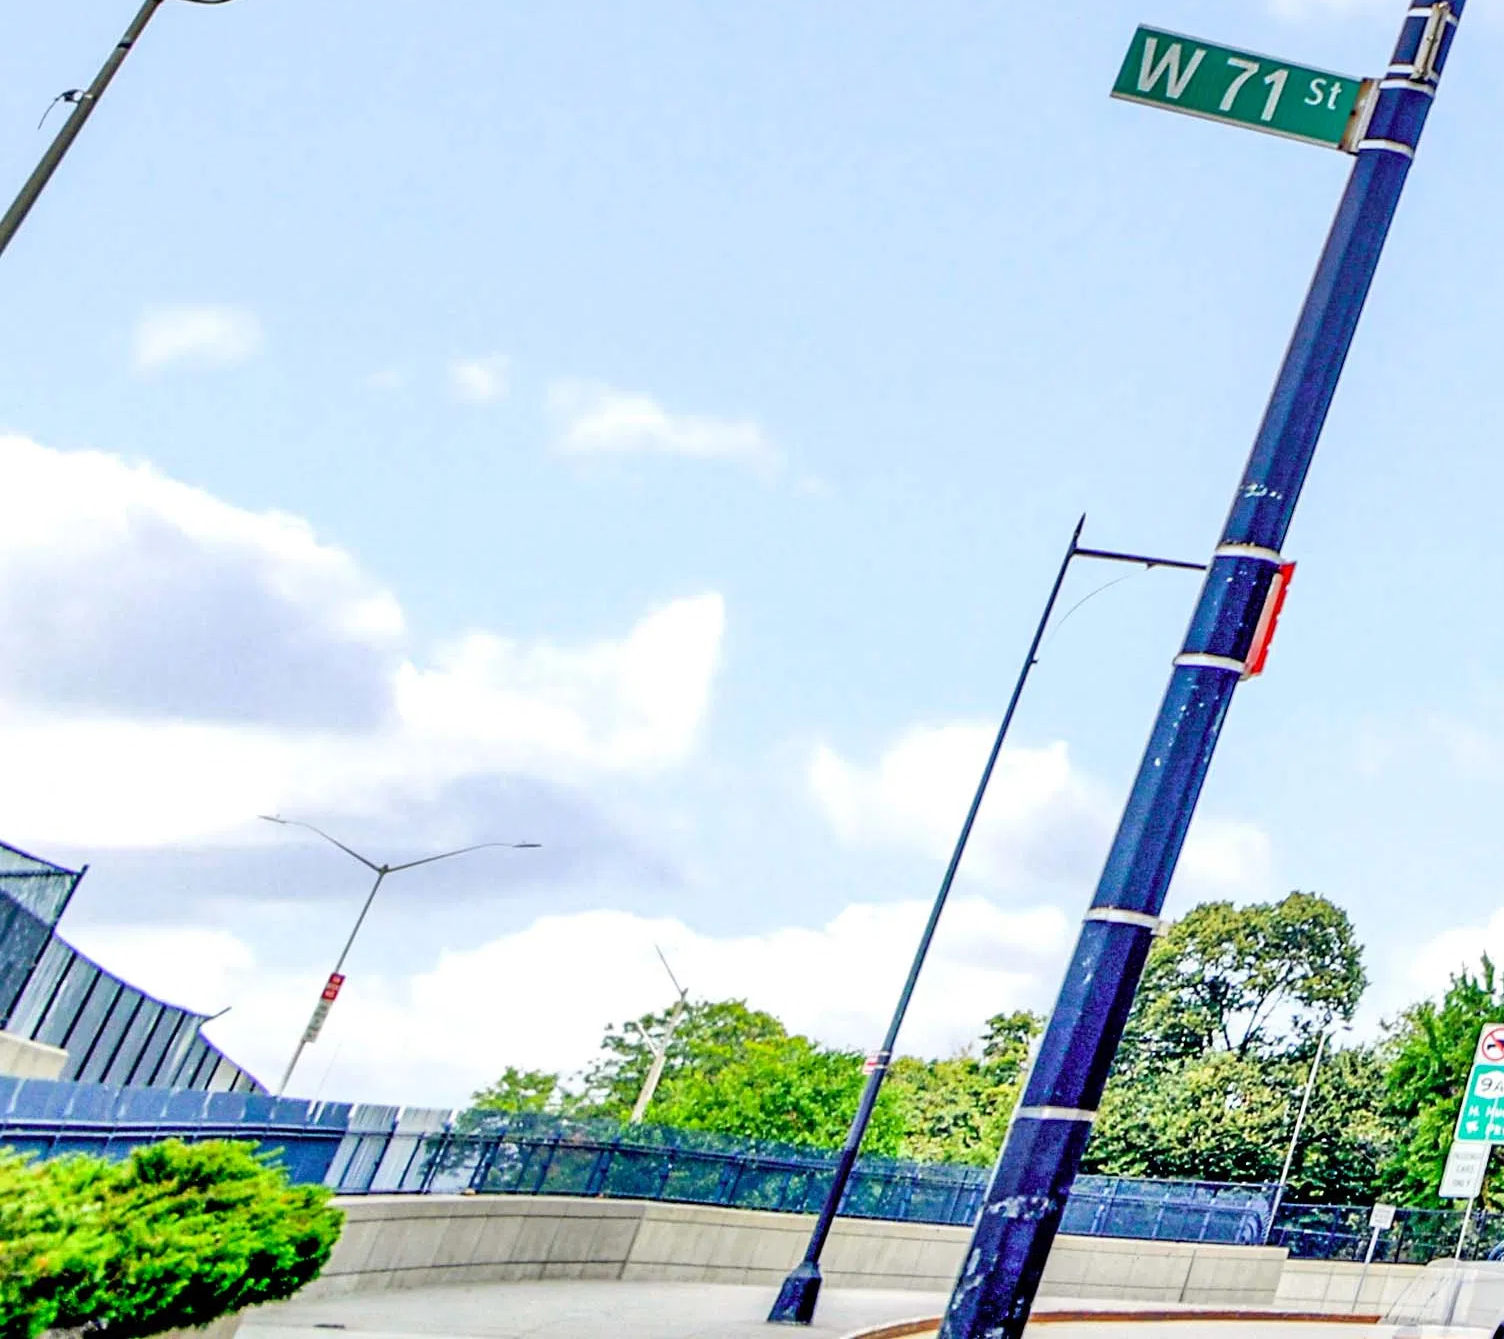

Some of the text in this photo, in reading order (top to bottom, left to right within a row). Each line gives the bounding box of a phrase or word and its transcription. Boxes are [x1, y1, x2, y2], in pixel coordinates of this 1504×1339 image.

[1136, 36, 1342, 122] W 71 St
[1480, 1077, 1504, 1092] 9A
